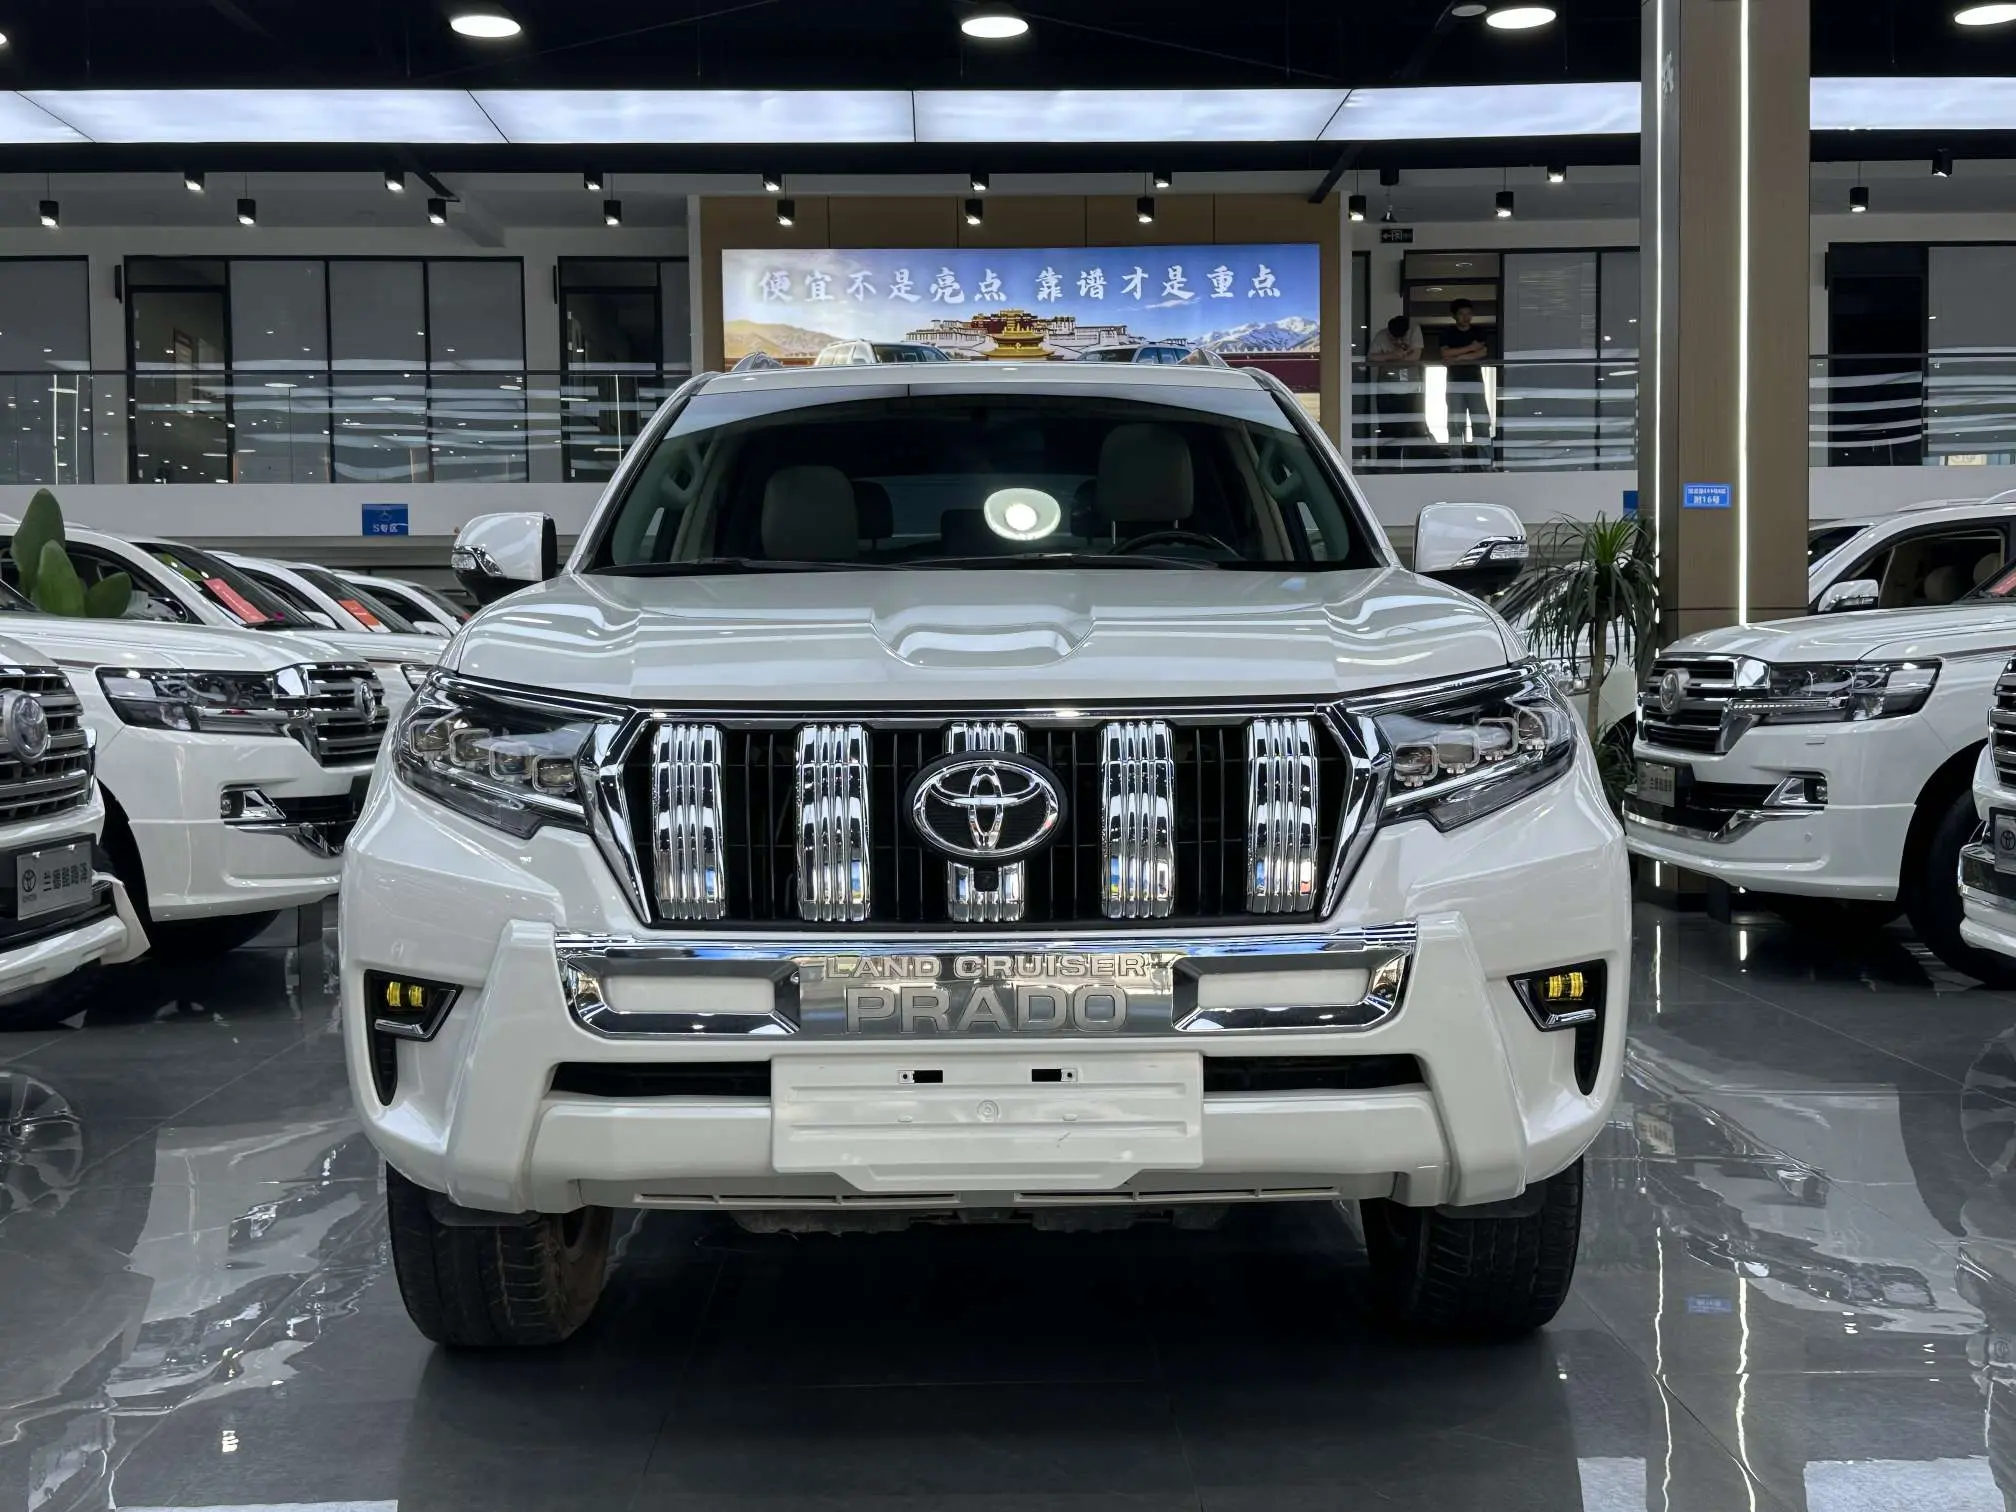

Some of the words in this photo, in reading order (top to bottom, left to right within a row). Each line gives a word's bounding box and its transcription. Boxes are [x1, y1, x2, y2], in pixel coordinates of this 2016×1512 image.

[758, 267, 1007, 303] 便宜不是亮点
[1035, 264, 1281, 301] 靠谱才是重点
[826, 955, 942, 978] LAND
[954, 954, 1147, 978] CRUISER
[845, 984, 1128, 1034] PRADO
